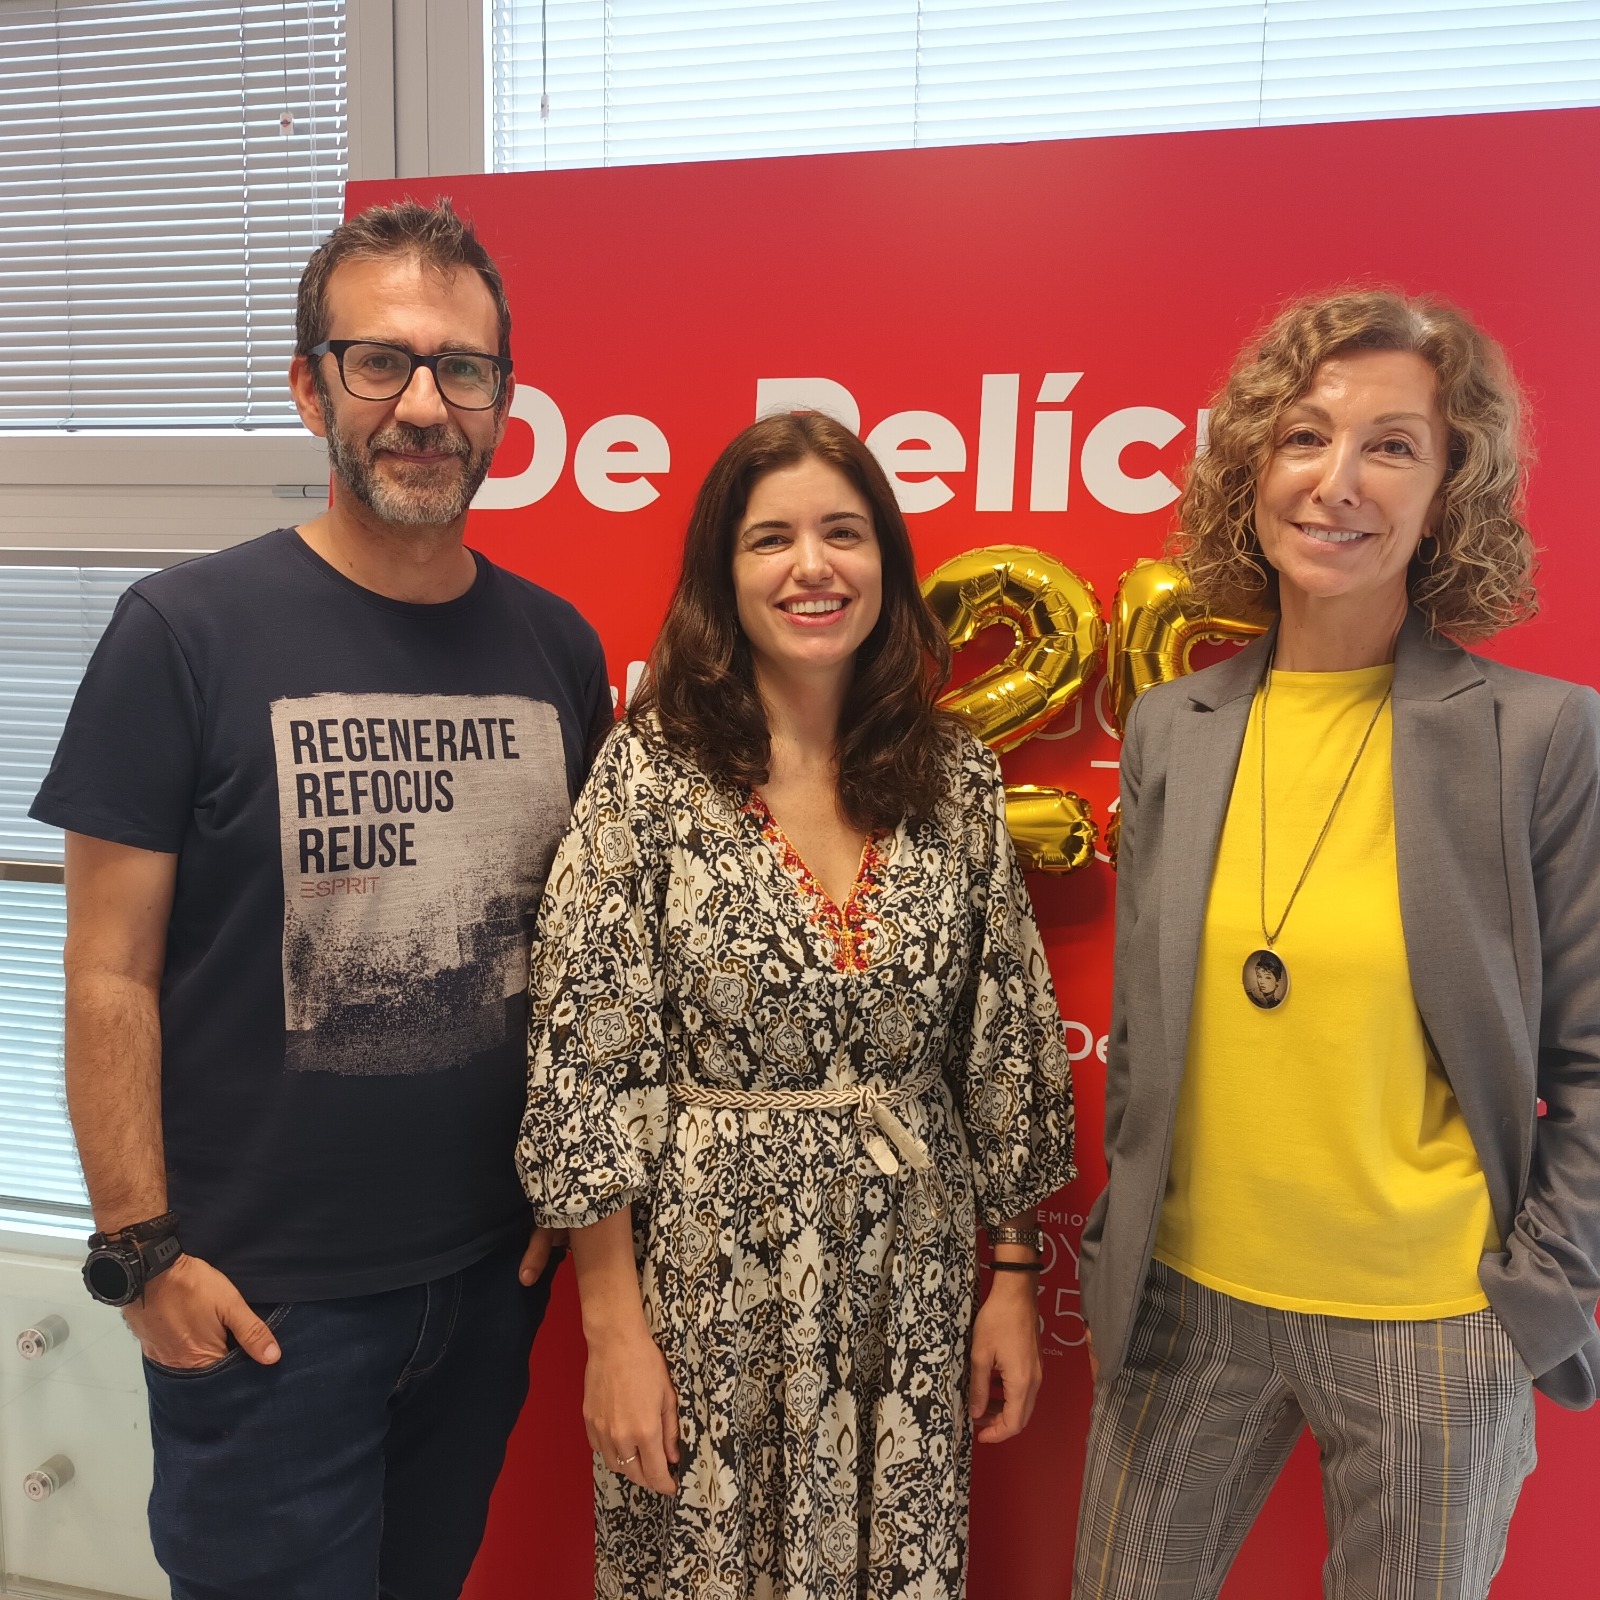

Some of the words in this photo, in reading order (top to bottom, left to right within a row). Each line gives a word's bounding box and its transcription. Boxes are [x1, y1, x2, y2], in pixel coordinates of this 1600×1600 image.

[469, 383, 671, 513] De
[755, 371, 1211, 515] Pelíc
[290, 718, 520, 764] REGENERATE
[296, 770, 454, 818] REFOCUS
[299, 823, 417, 874] REUSE
[300, 876, 380, 898] ESPRIT
[1037, 1209, 1090, 1227] EMIO
